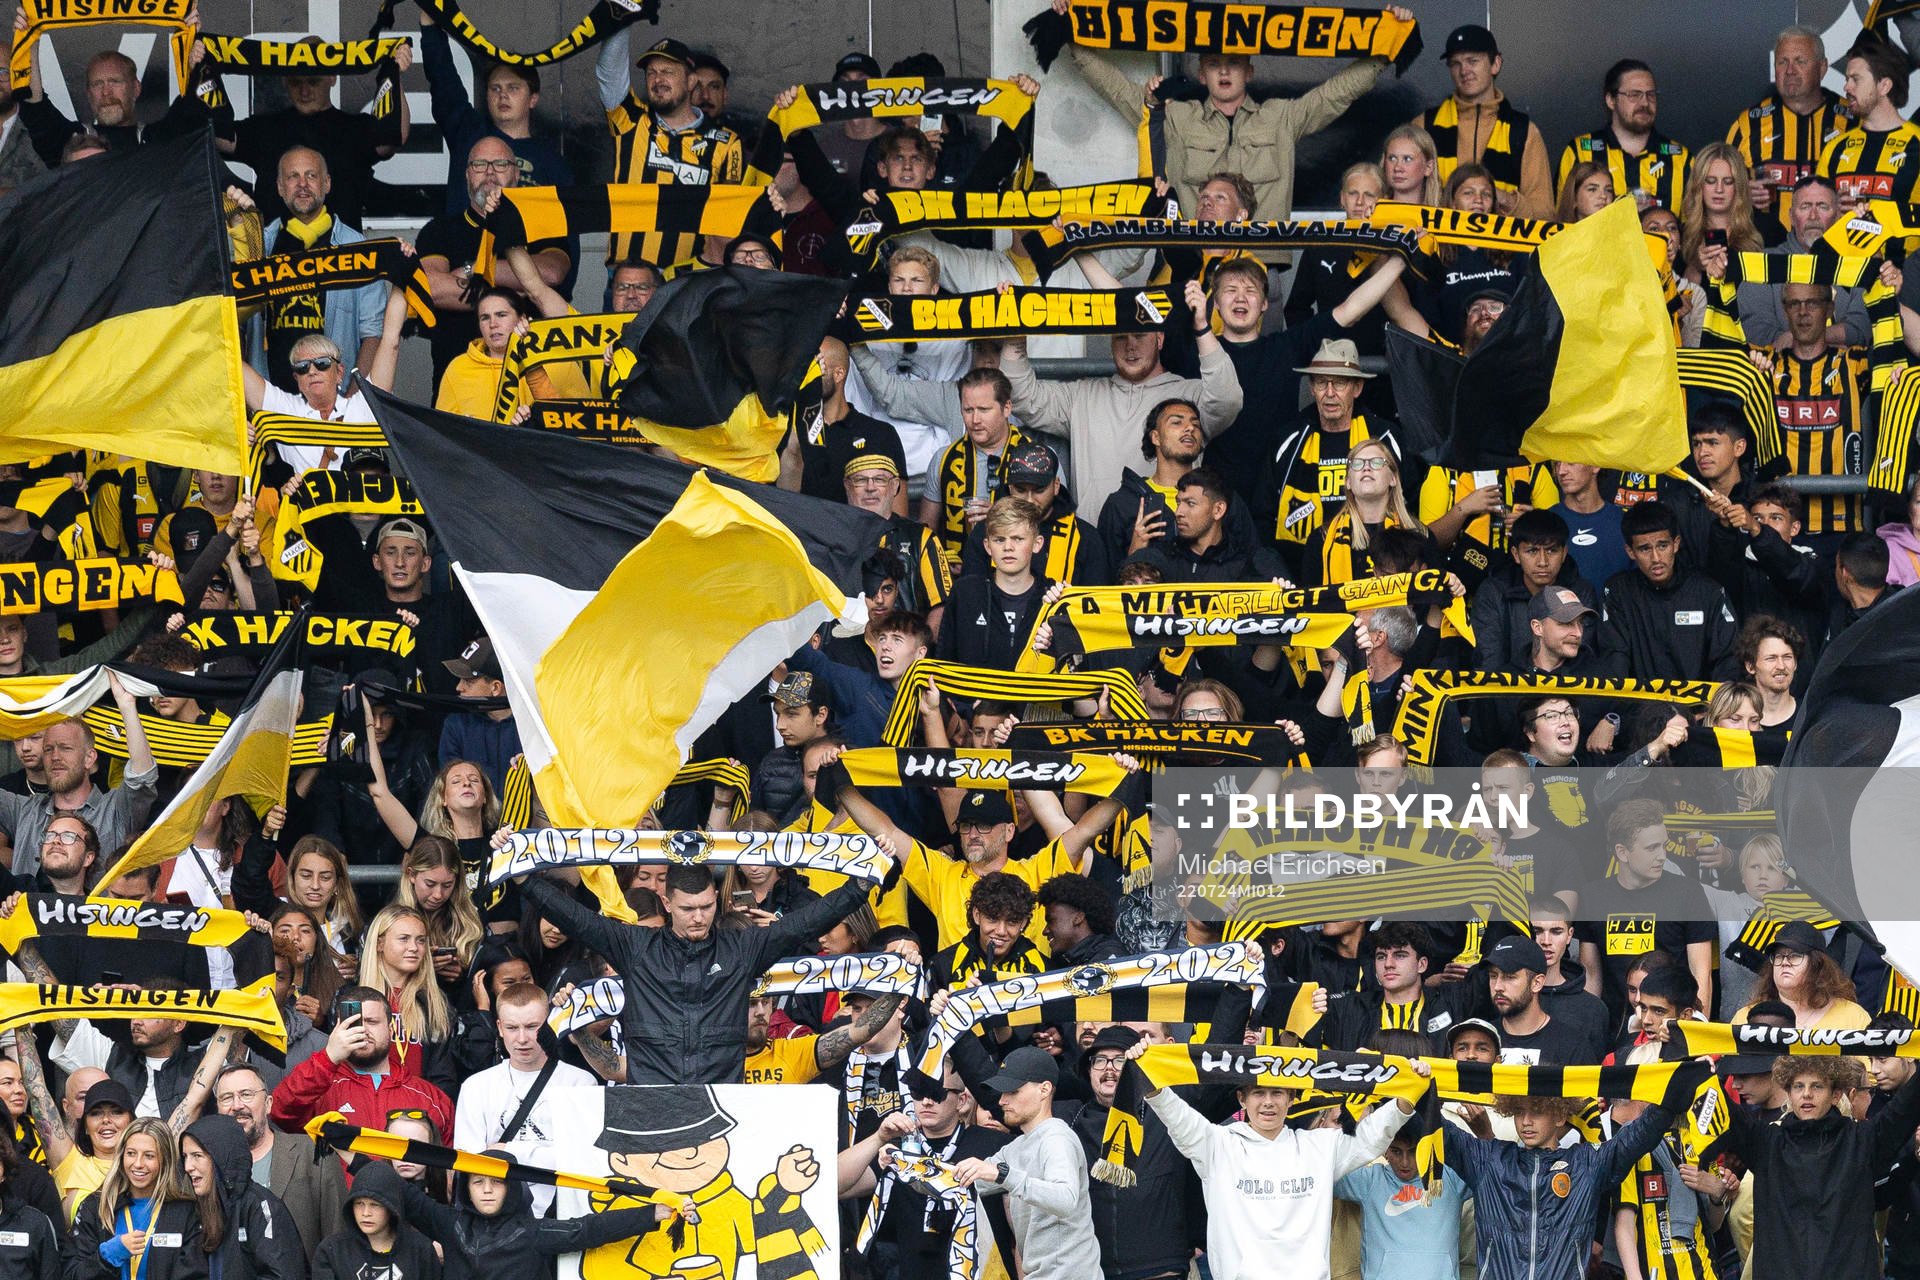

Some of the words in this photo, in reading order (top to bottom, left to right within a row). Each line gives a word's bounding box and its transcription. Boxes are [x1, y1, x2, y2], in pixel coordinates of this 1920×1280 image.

[1073, 5, 1378, 49] HISINGEN
[818, 87, 1001, 111] HISINGEN
[886, 192, 956, 224] BK
[251, 252, 377, 286] HÄCKEN
[911, 299, 963, 330] BK
[543, 411, 586, 430] BK
[1778, 406, 1838, 419] BRA
[1, 565, 154, 606] NGEN
[1135, 615, 1308, 636] HISINGEN
[1044, 728, 1096, 745] BK
[904, 755, 1085, 783] HISINGEN
[508, 830, 639, 874] 2012
[736, 831, 874, 878] 2022
[38, 899, 210, 932] HISINGEN
[1608, 917, 1653, 932] HÄC
[1608, 938, 1650, 951] KEN
[39, 984, 220, 1009] HISINGEN
[928, 975, 1043, 1052] 2012
[1201, 1051, 1399, 1084] HISINGEN
